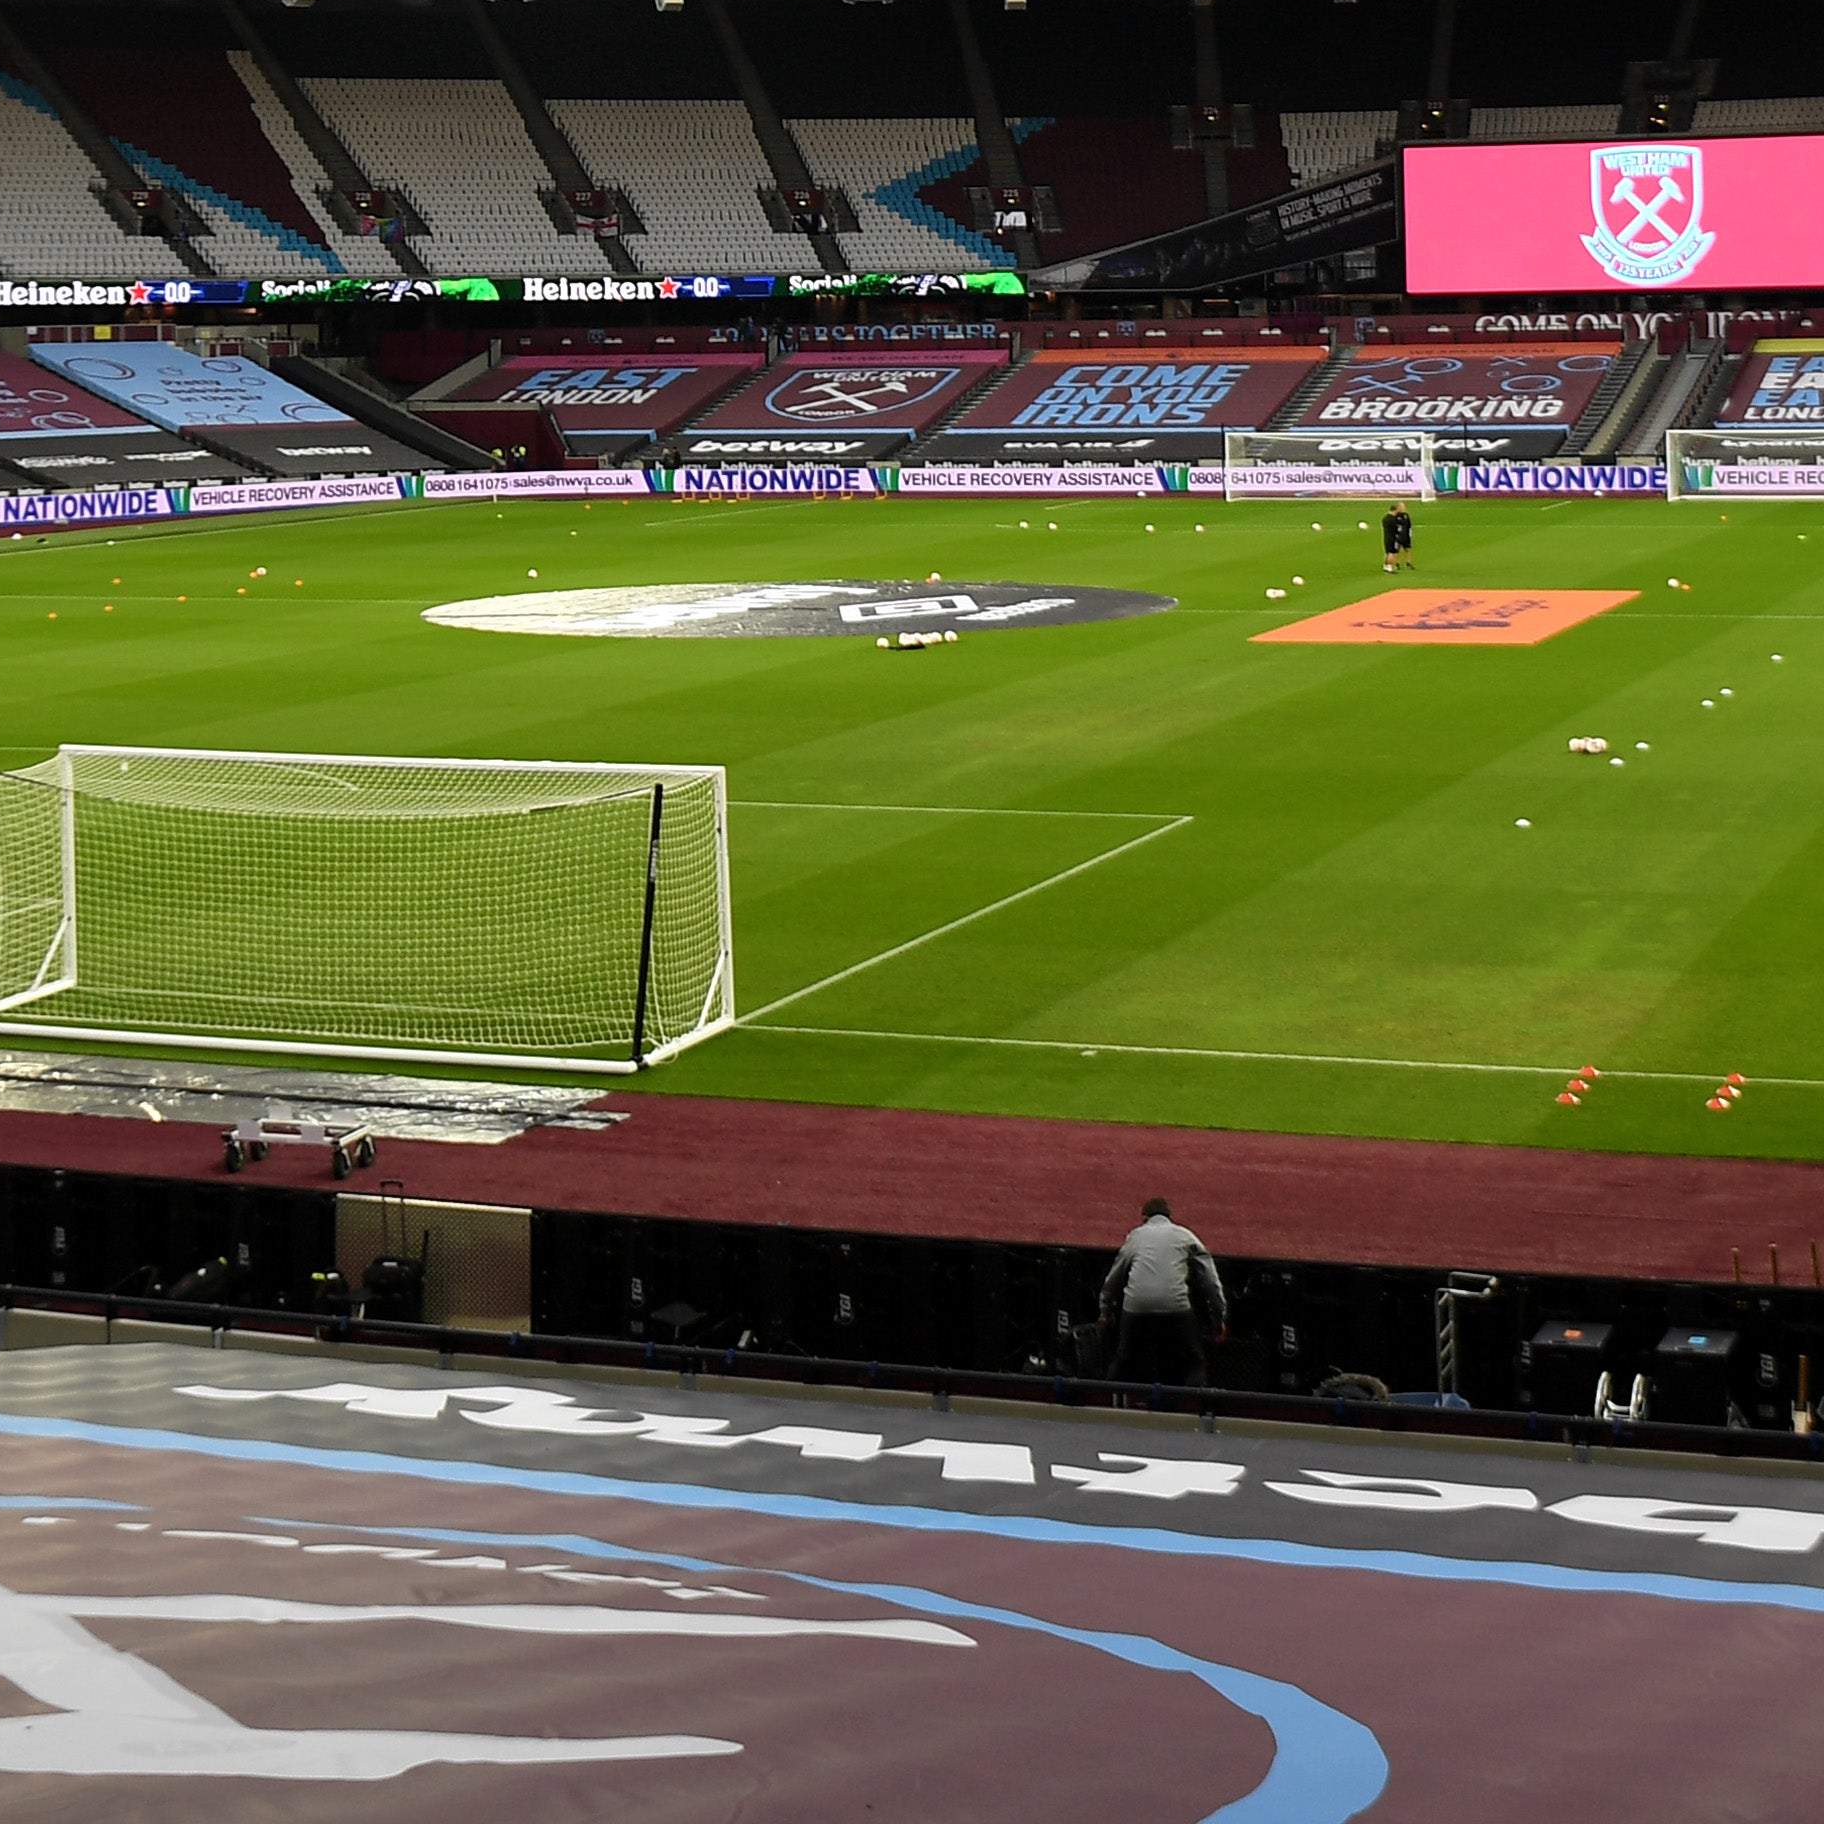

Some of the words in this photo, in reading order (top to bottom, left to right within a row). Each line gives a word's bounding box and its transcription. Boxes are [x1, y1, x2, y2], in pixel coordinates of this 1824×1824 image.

[1602, 153, 1646, 169] WEST
[1647, 152, 1689, 167] HAM
[1620, 164, 1670, 177] UNITED
[524, 277, 655, 301] Heineken
[522, 367, 700, 391] EAST
[1055, 364, 1251, 388] COME
[498, 389, 658, 405] LONDON
[1035, 386, 1102, 405] ON
[1125, 385, 1233, 404] YOU
[1010, 403, 1213, 426] IRONS
[1318, 399, 1564, 420] BROOKING
[276, 446, 372, 457] betway
[688, 440, 866, 456] betway
[1317, 438, 1514, 452] betway
[425, 476, 509, 493] 08081641075
[512, 473, 634, 491] sales@nwva.co.uk
[684, 468, 860, 492] NATIONWIDE
[902, 471, 967, 487] VEHICLE
[970, 471, 1055, 487] RECOVERY
[1057, 471, 1154, 487] ASSISTANCE
[1189, 472, 1281, 486] 0808641075
[1286, 470, 1414, 486] sales@nwva.co.uk
[1470, 467, 1667, 491] NATIONWIDE
[1715, 471, 1790, 485] VEHICLE
[193, 490, 245, 507] VEHICLE
[248, 485, 317, 503] RECOVERY
[318, 480, 395, 499] ASSISTANCE
[3, 490, 159, 523] NATIONWIDE
[631, 1277, 644, 1304] TGI
[838, 1293, 853, 1321] TGI
[1057, 1309, 1069, 1334] TGI
[1281, 1323, 1297, 1354] TGI
[1759, 1352, 1776, 1382] TGI
